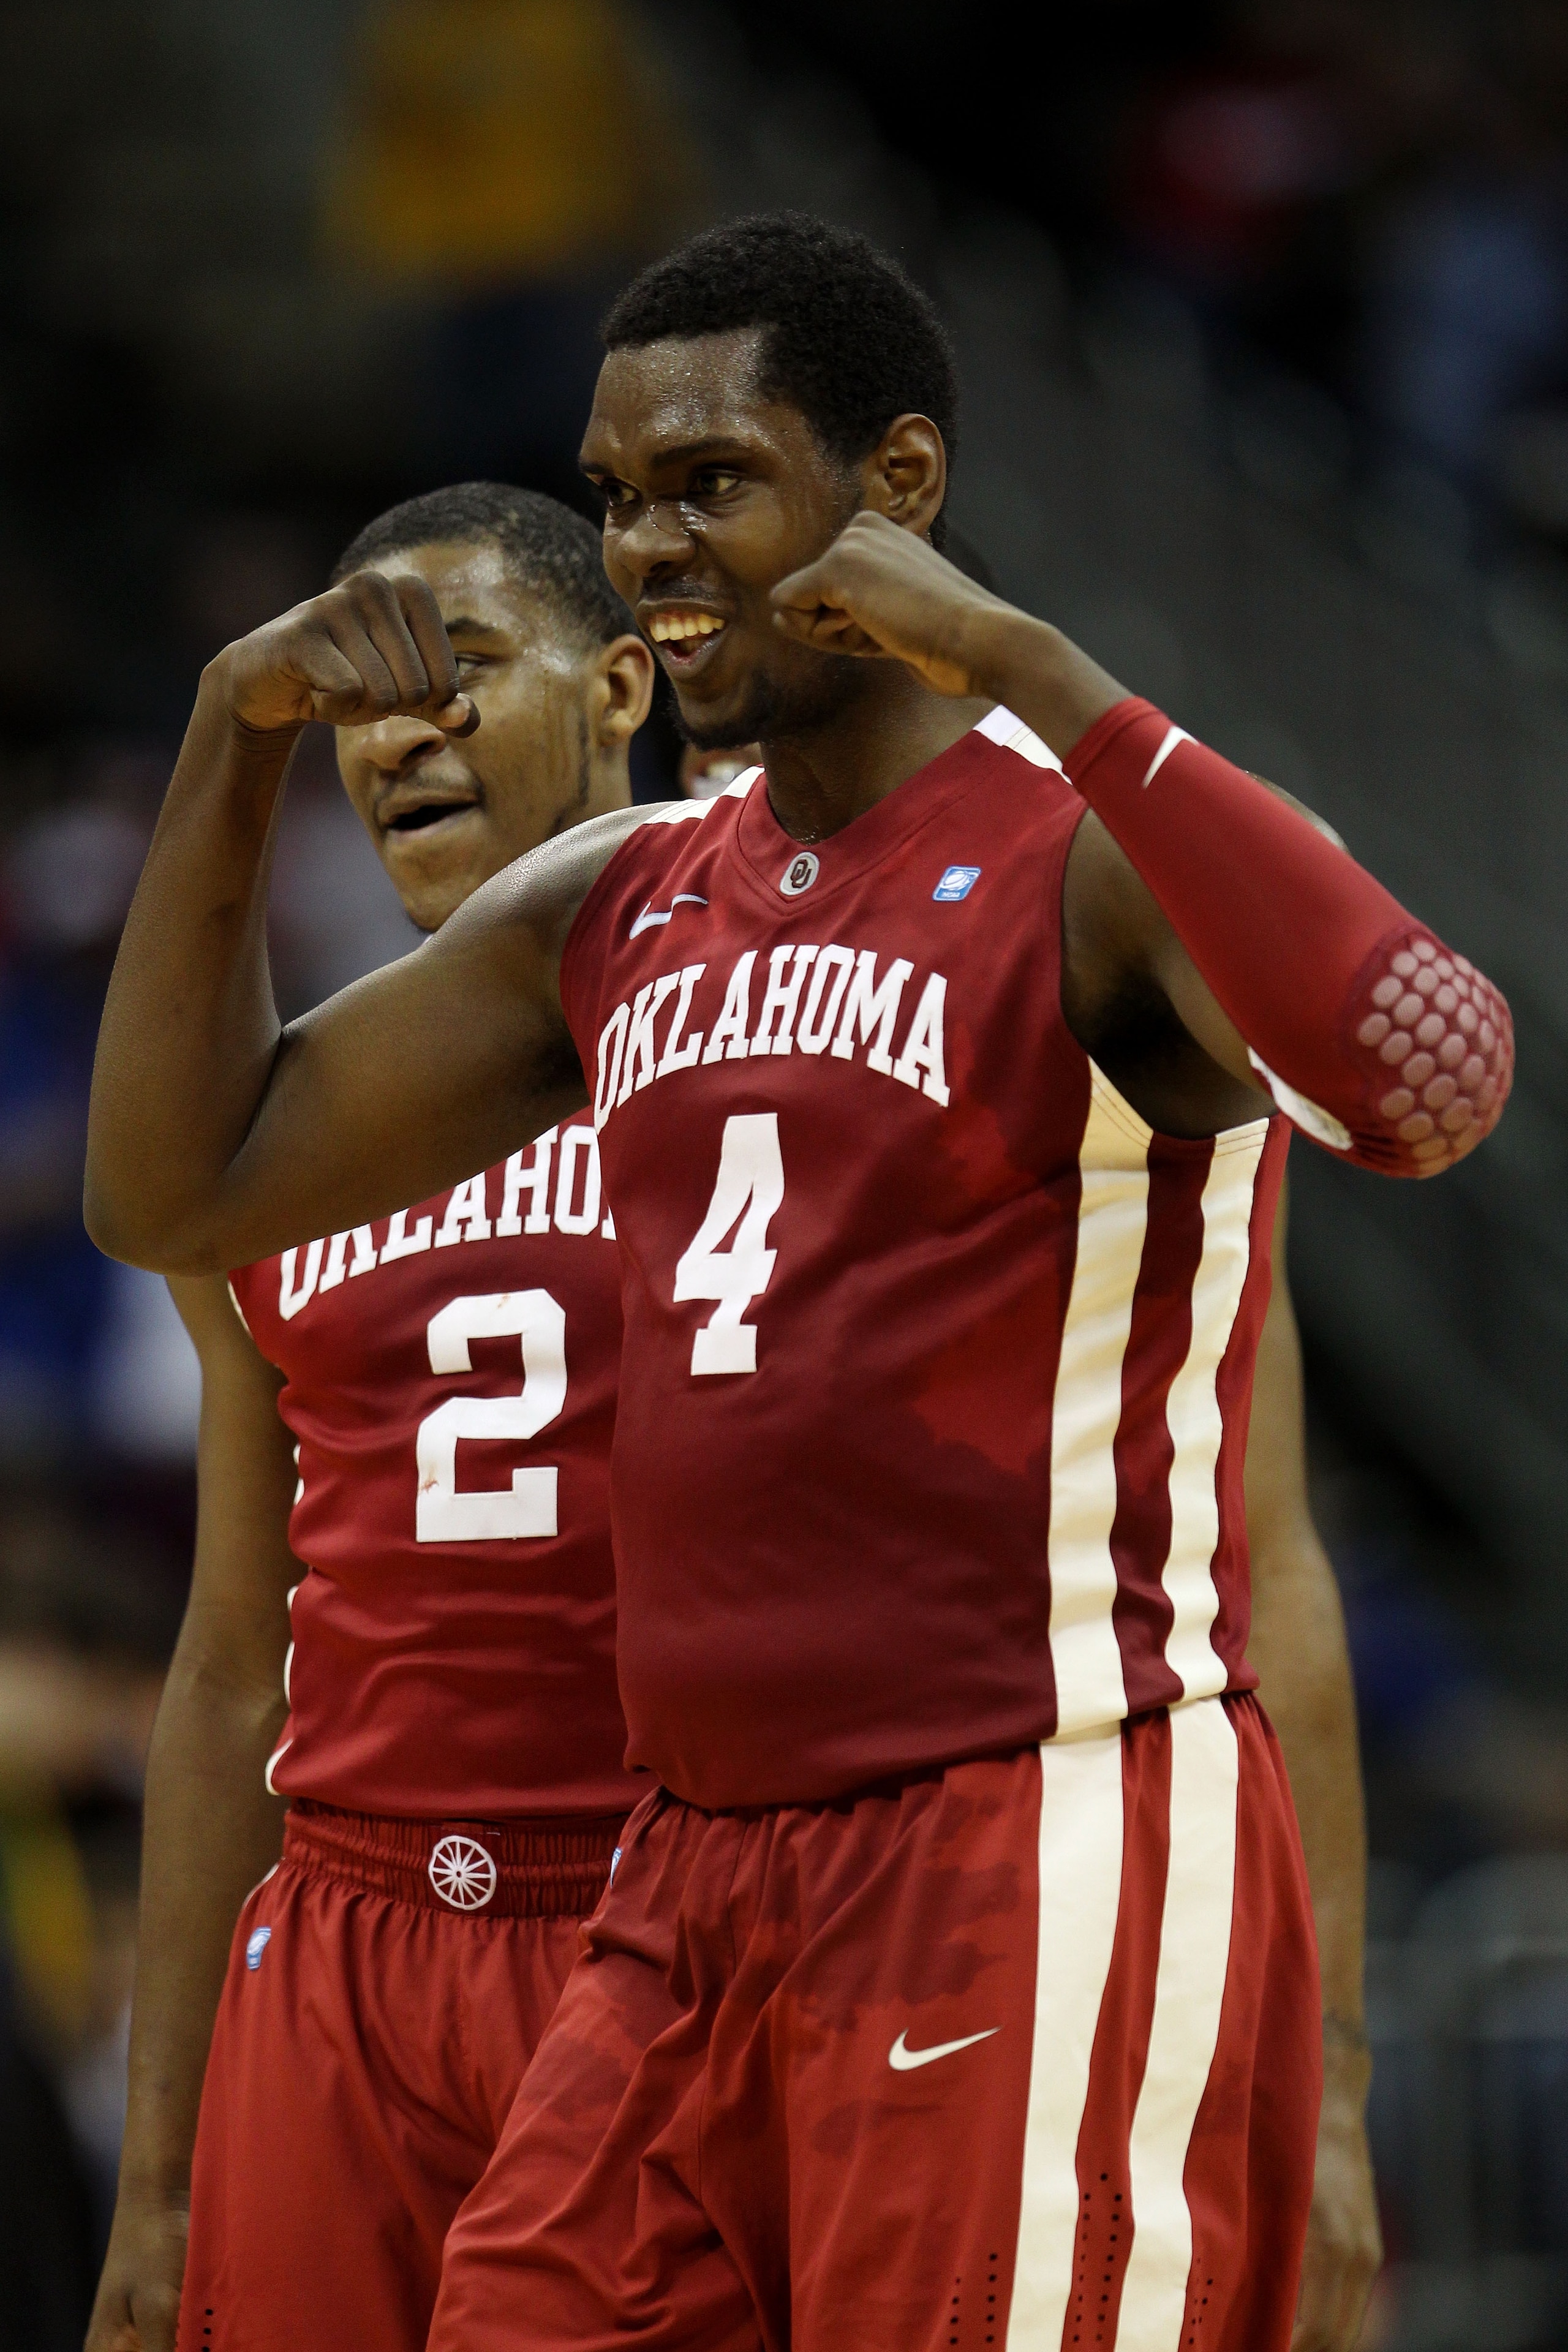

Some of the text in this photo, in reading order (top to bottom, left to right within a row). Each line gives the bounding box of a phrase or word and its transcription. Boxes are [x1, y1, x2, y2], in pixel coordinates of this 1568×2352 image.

[594, 944, 951, 1135] OKLAHOMA
[279, 1125, 617, 1321] OKLAHO
[674, 1113, 786, 1376] 4
[416, 1288, 567, 1543] 2
